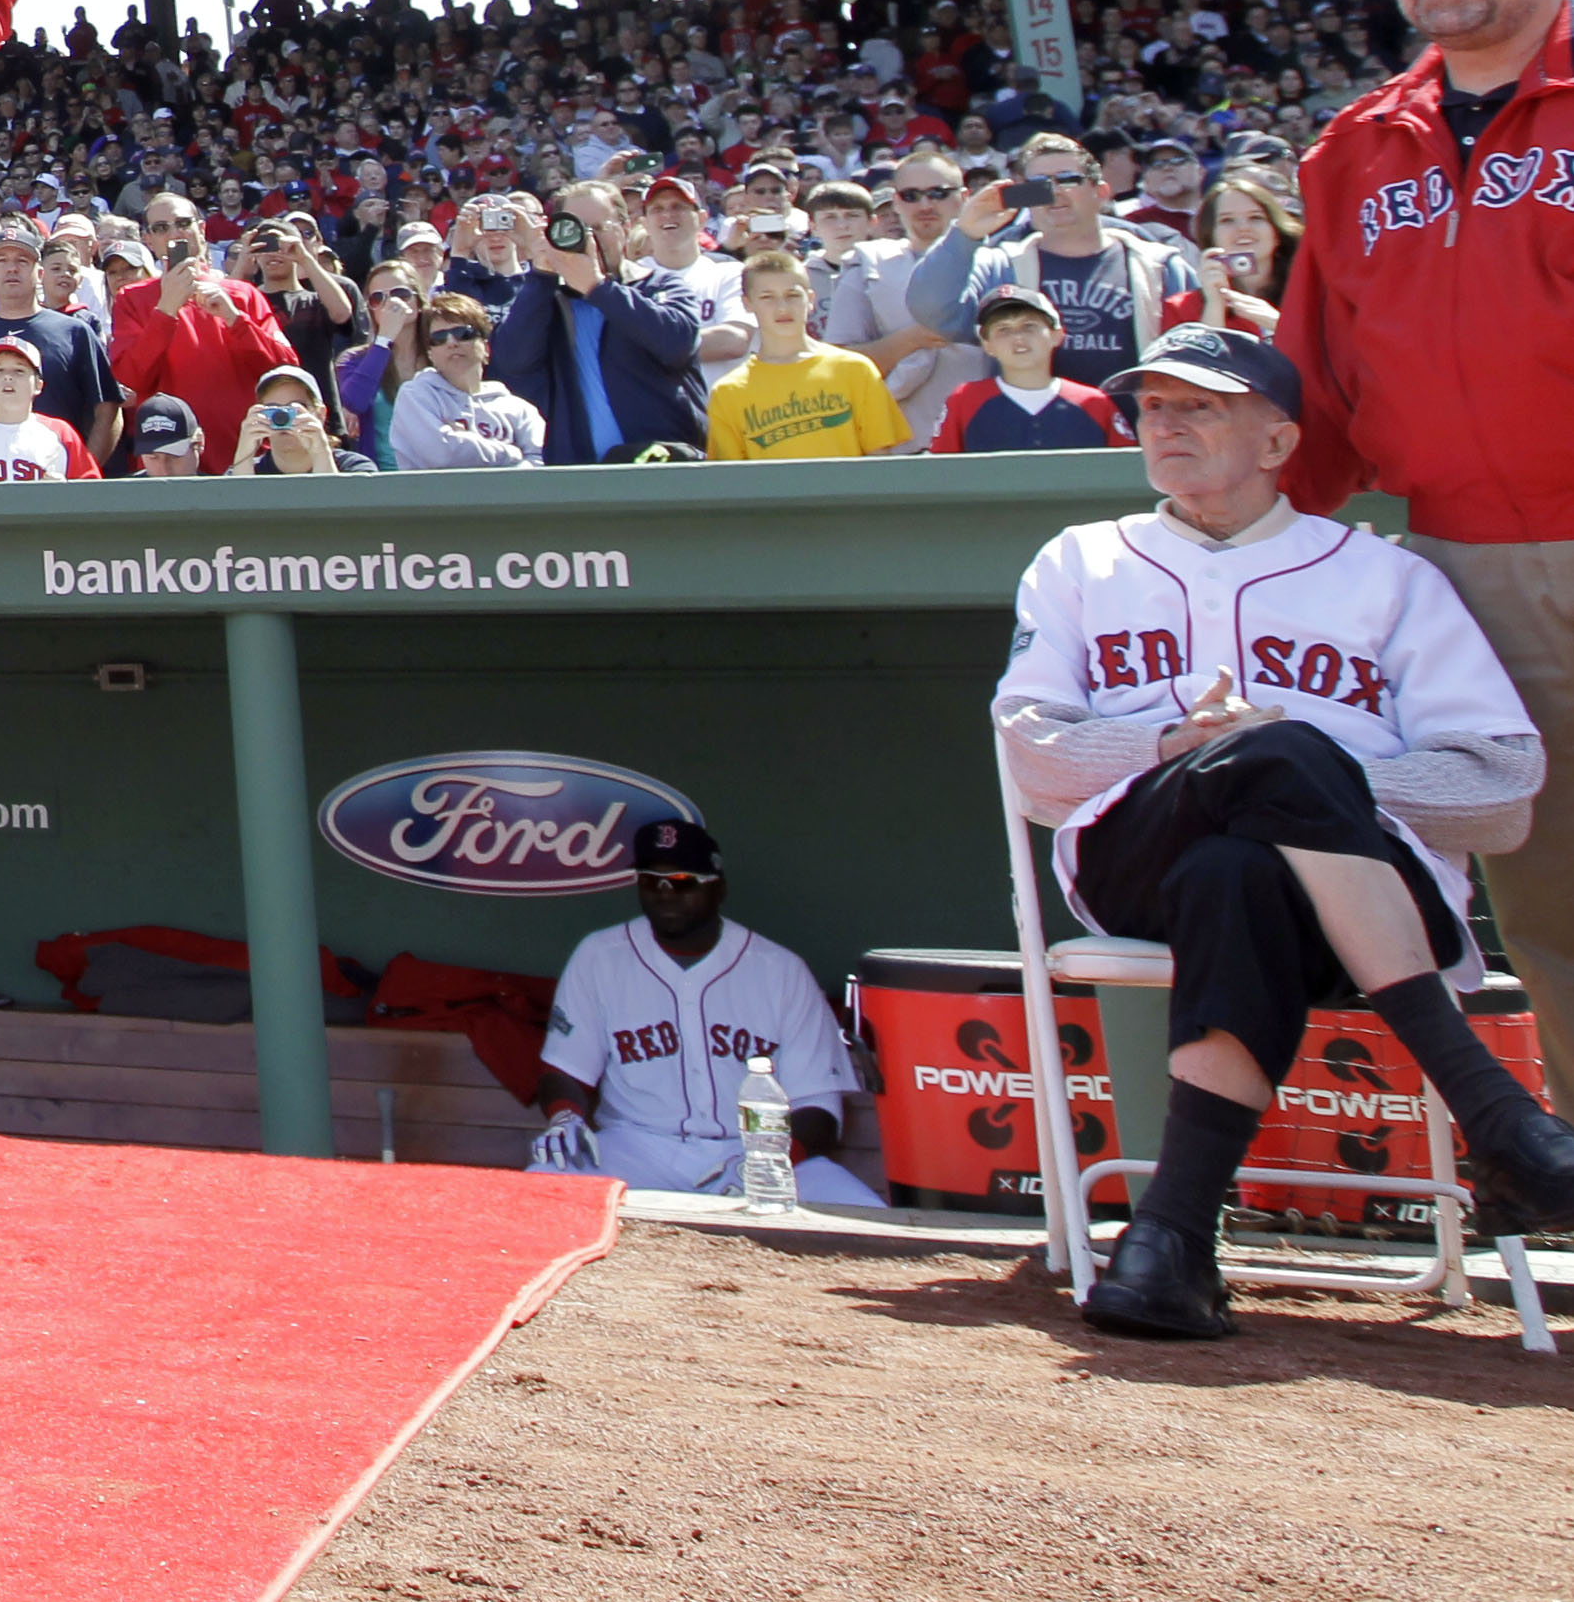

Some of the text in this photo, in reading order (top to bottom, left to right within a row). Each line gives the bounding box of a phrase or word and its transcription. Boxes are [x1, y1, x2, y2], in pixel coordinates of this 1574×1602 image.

[1032, 37, 1063, 69] 15
[743, 389, 852, 436] Manchester
[42, 542, 630, 596] bankofamerica.com
[1086, 627, 1389, 718] ED SOX
[389, 773, 628, 869] Ford
[613, 1019, 681, 1065] RED
